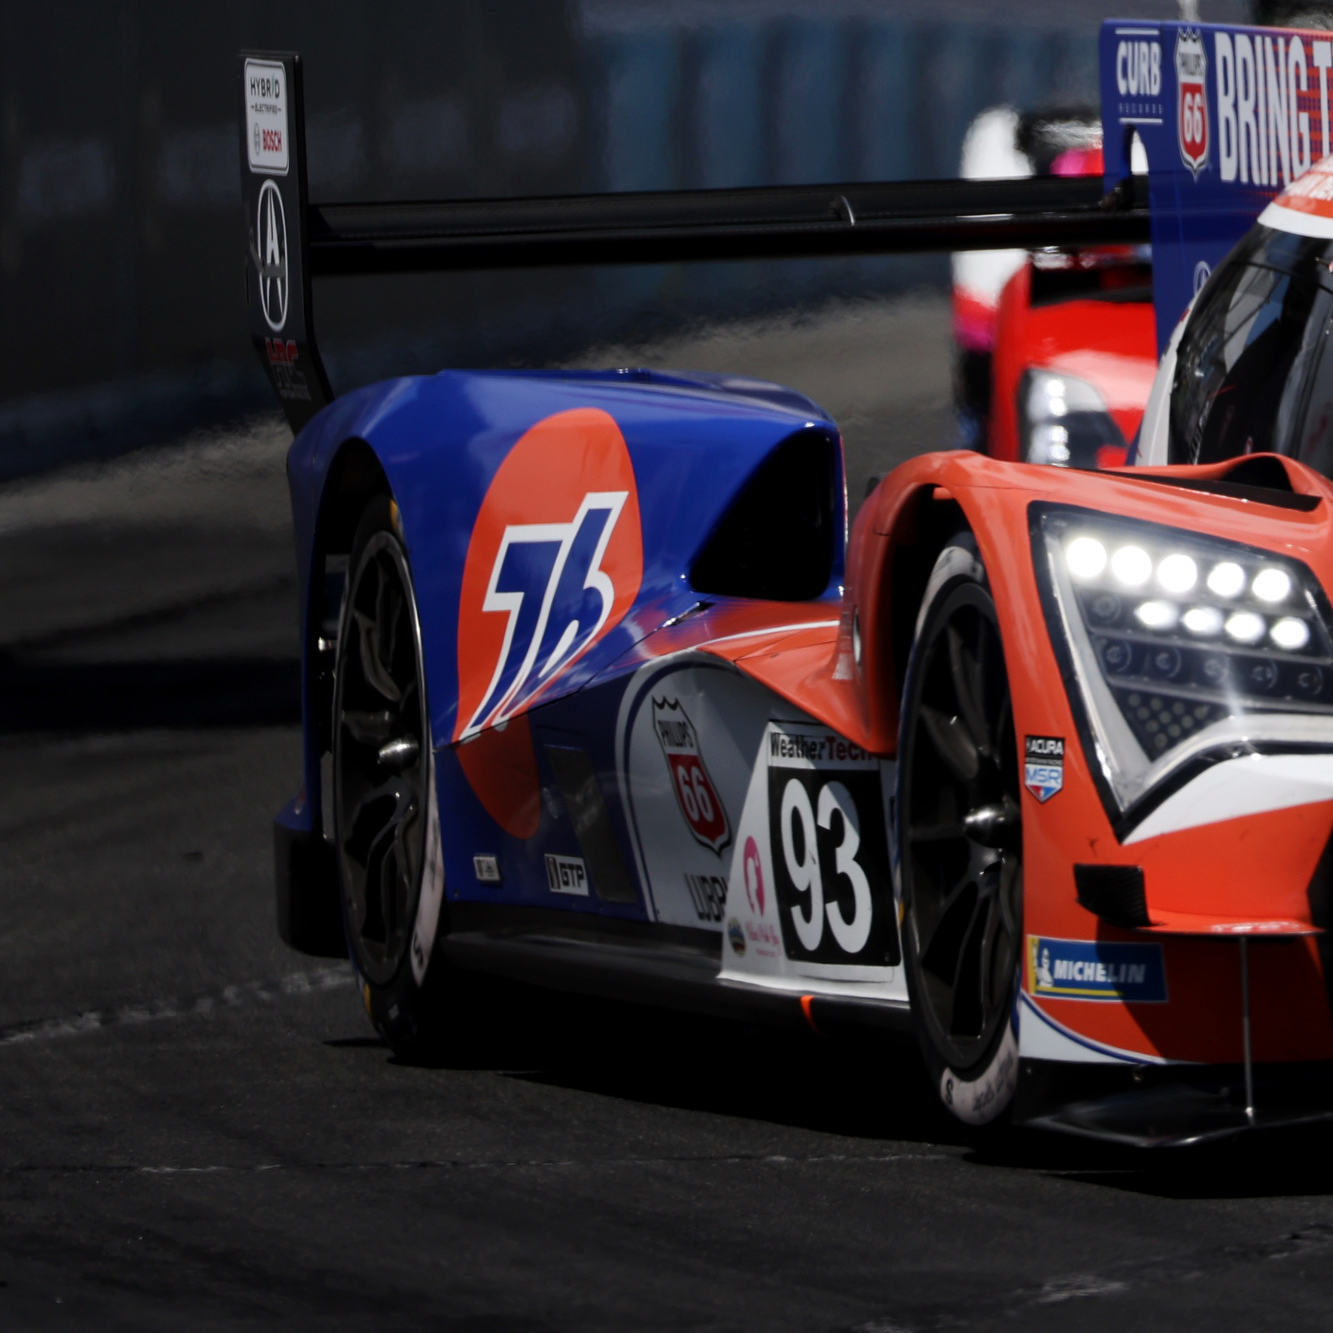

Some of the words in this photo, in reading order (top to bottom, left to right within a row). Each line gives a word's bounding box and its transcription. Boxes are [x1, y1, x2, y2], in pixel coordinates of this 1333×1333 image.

[249, 73, 280, 99] HYBRID
[1117, 40, 1162, 96] CURB
[1184, 92, 1203, 144] 66
[1214, 32, 1311, 186] BRING
[262, 129, 282, 153] BOSCH
[462, 491, 629, 739] 76
[1030, 738, 1064, 756] ACURA
[676, 764, 715, 823] 66
[1026, 768, 1061, 785] MSR
[559, 863, 584, 888] GTP
[781, 778, 872, 953] 93
[1053, 959, 1147, 984] MICHELIN
